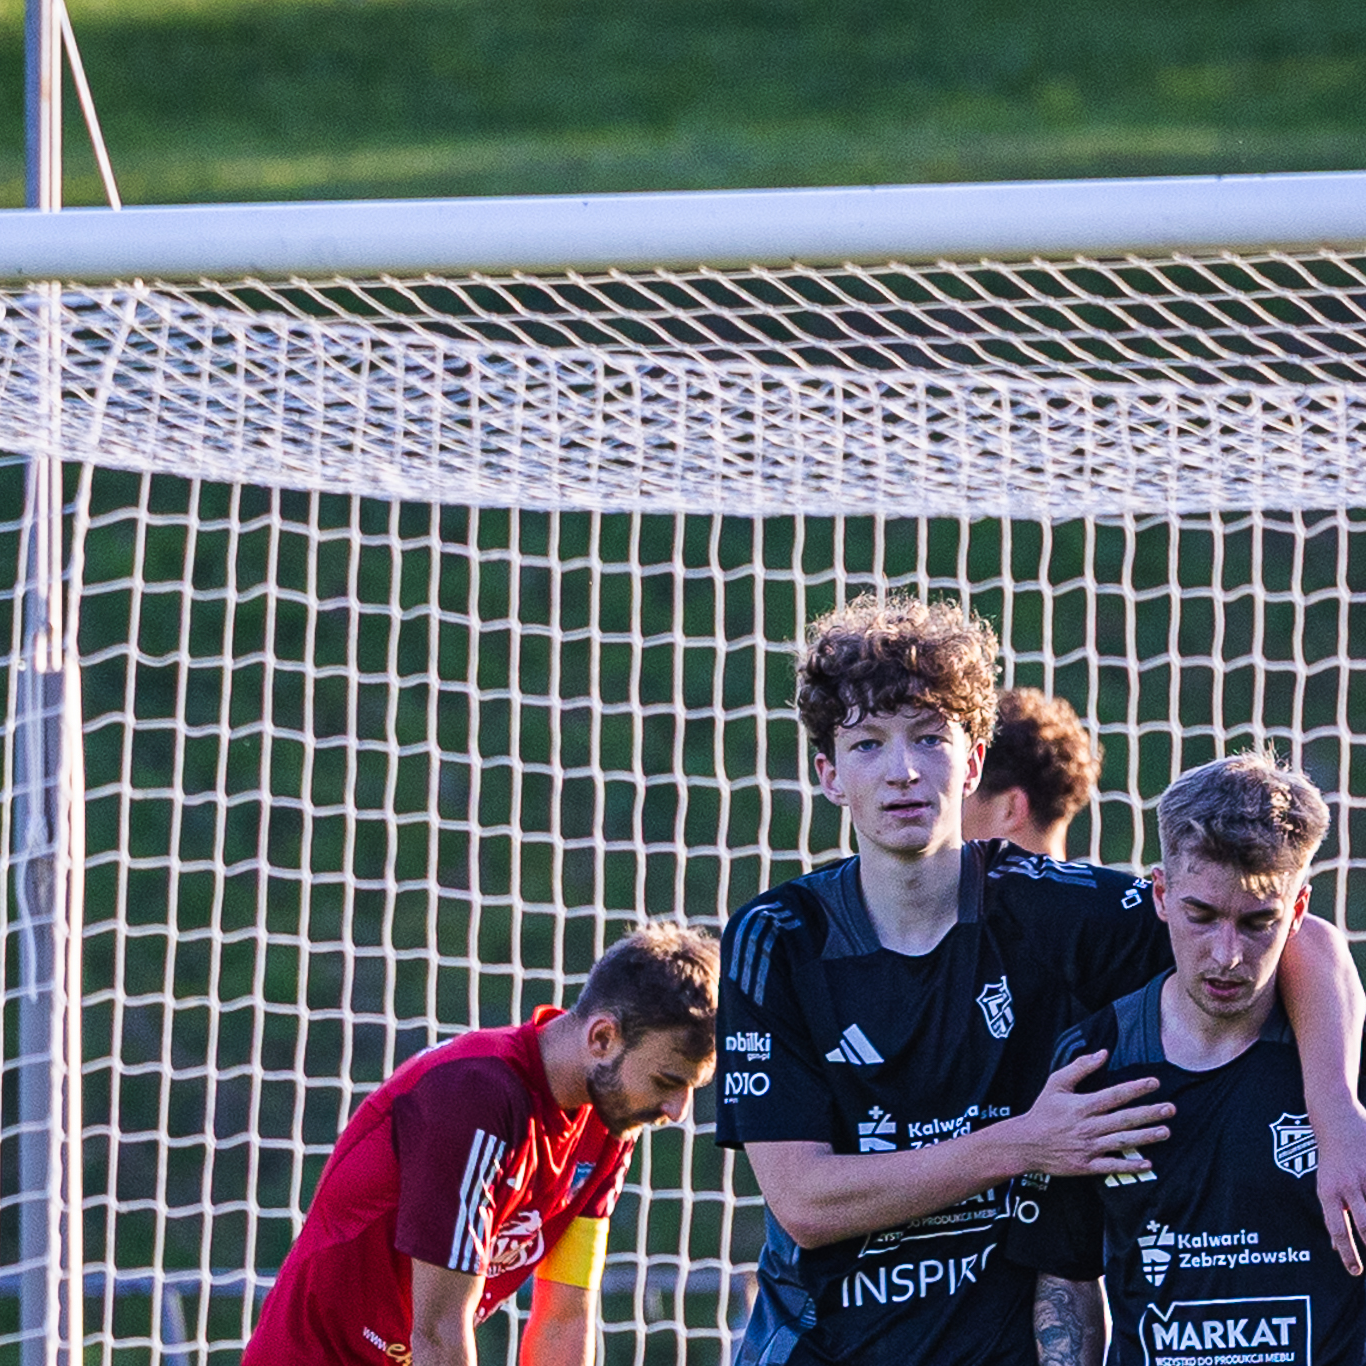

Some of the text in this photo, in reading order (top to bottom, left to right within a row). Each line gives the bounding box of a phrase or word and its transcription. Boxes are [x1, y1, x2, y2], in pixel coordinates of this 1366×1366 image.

[1178, 1229, 1259, 1249] Kalwaria
[1179, 1247, 1311, 1270] Zebrzydowska
[1151, 1316, 1297, 1351] MARKAT
[1197, 1356, 1213, 1366] DO
